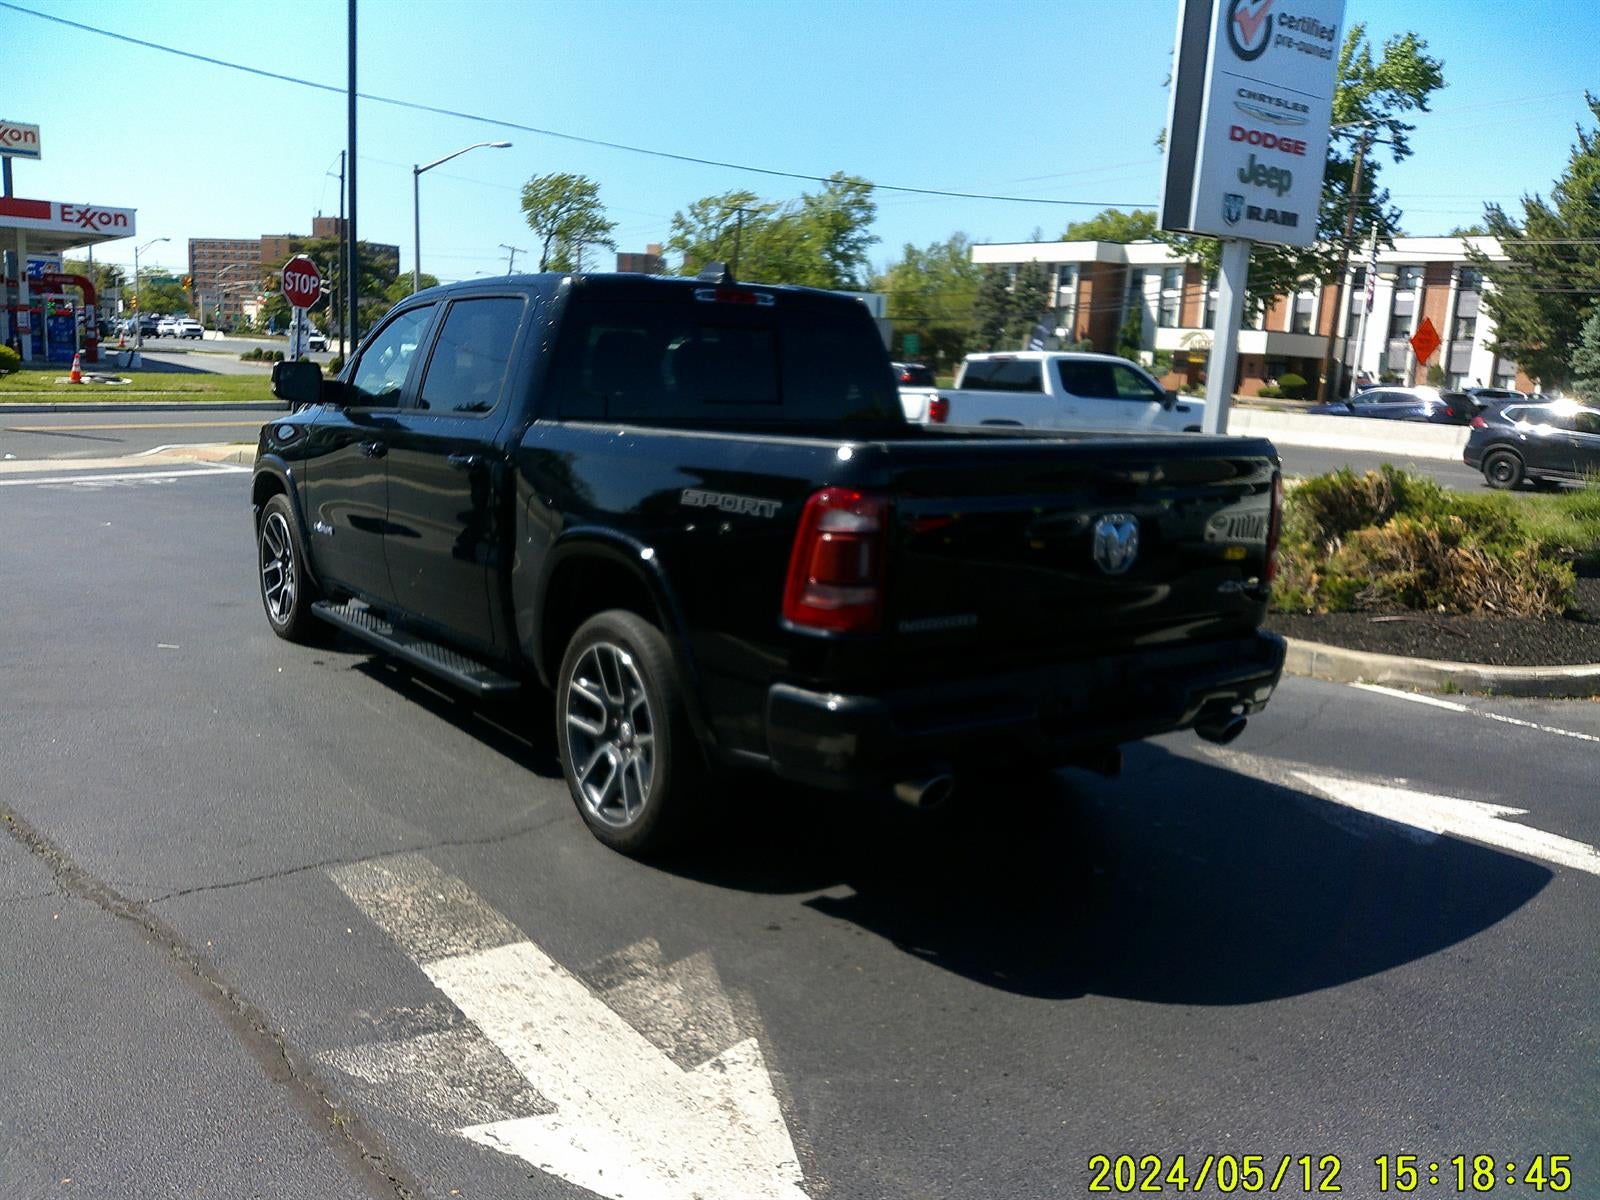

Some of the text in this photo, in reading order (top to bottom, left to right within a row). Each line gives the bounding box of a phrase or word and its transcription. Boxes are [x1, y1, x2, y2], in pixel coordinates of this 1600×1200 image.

[1274, 33, 1333, 60] pre-owned
[1237, 88, 1310, 113] CHRYSLER
[0, 126, 36, 146] xon
[1229, 125, 1307, 156] DODGE
[1237, 153, 1292, 197] Jeep
[60, 204, 128, 231] Exxon
[1246, 205, 1299, 228] RAM
[283, 272, 321, 295] STOP
[680, 489, 782, 519] SPORT
